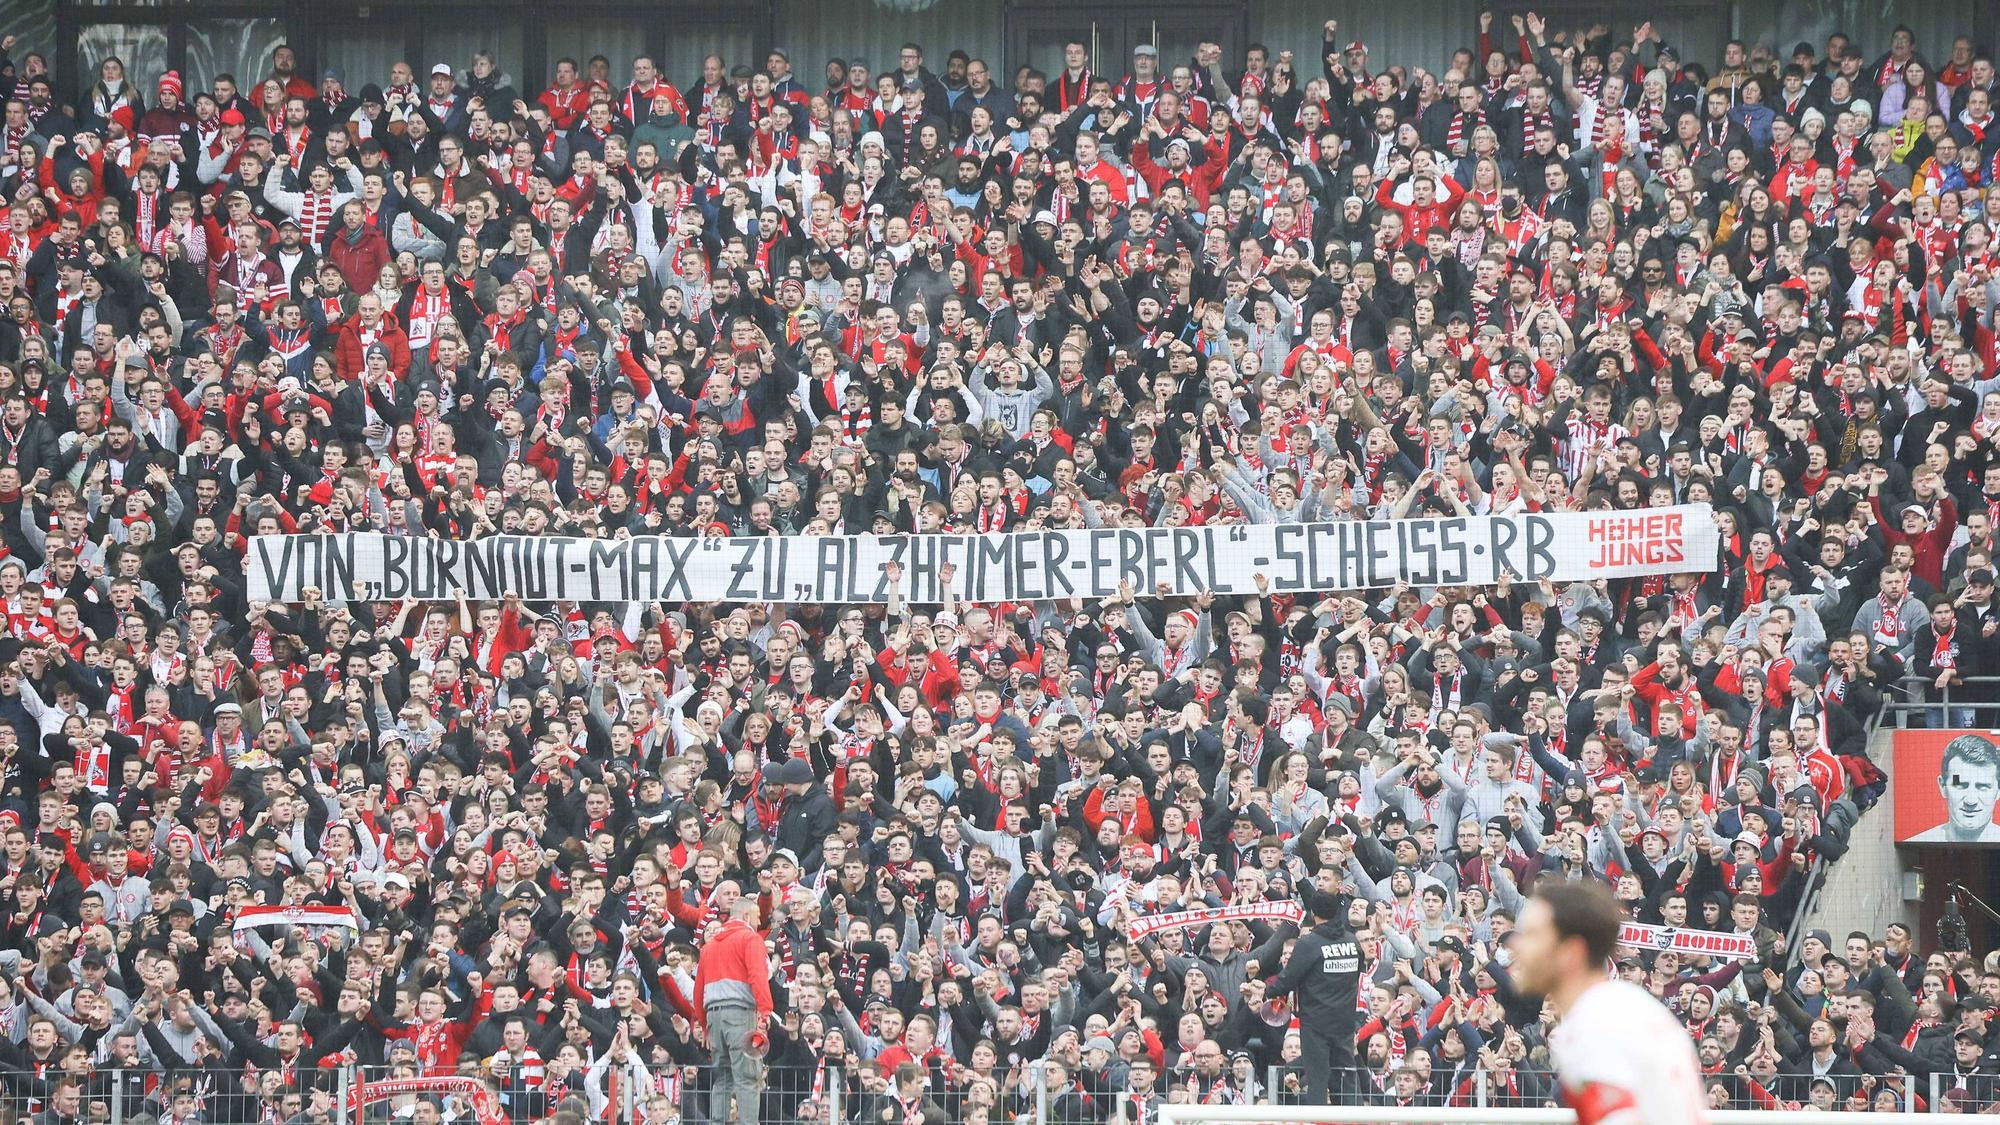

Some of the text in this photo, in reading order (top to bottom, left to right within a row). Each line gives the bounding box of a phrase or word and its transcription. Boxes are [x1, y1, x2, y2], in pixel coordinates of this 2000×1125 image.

[1589, 539, 1684, 568] JUNGS
[257, 533, 354, 601] VON
[726, 537, 788, 600] ZU
[1321, 942, 1358, 959] REWE
[1675, 933, 1753, 953] HORDE
[1325, 960, 1358, 970] uhlsport
